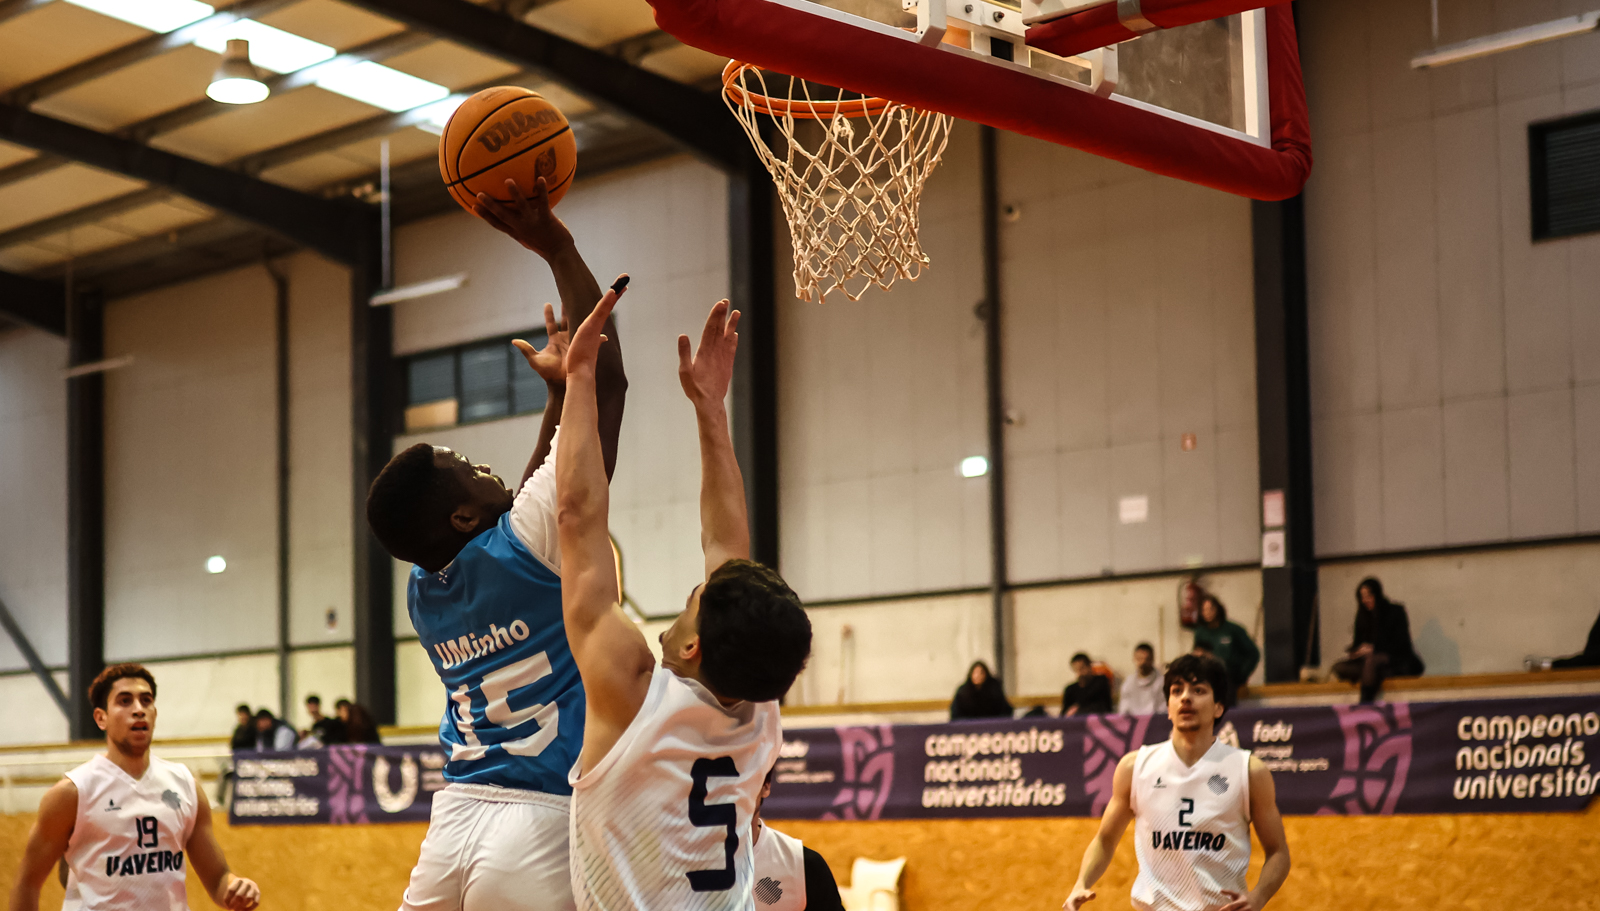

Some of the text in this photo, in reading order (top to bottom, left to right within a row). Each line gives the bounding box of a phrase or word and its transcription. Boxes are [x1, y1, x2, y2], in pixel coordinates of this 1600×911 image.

[477, 108, 561, 153] Wilson
[434, 619, 530, 670] UMinho
[450, 650, 560, 762] 15
[925, 727, 1064, 758] campeonatos
[1253, 720, 1293, 743] fadu
[924, 755, 1022, 783] nacionais
[1456, 737, 1585, 771] nacionais
[922, 778, 1066, 808] universitários
[685, 756, 740, 892] 5
[1179, 797, 1194, 827] 2
[136, 816, 158, 849] 19
